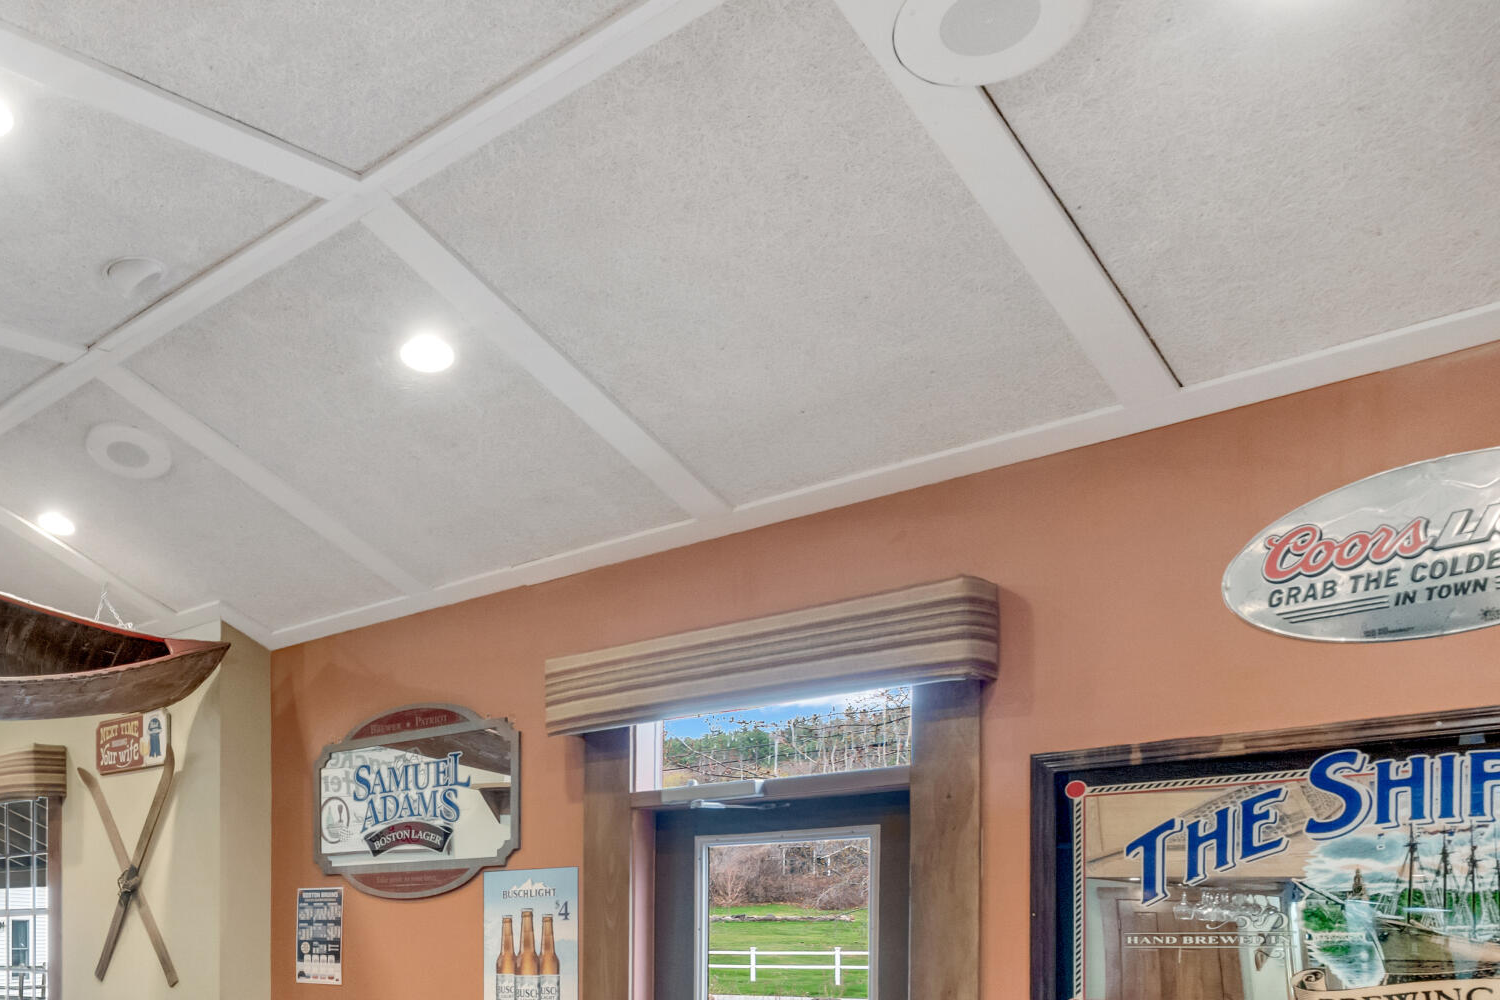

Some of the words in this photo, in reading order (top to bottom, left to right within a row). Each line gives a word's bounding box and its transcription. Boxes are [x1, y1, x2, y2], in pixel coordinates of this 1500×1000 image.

[1261, 517, 1431, 584] Coors
[1433, 503, 1500, 552] LI
[1268, 579, 1338, 608] GRAB
[1350, 567, 1400, 594] THE
[1394, 589, 1418, 607] IN
[1425, 577, 1489, 601] TOWN
[100, 724, 119, 744] NEXT
[120, 719, 139, 738] TIME
[117, 738, 139, 768] wife
[352, 750, 471, 802] SAMUEL
[360, 788, 461, 834] ADAMS
[373, 830, 410, 850] BOSTON
[411, 829, 444, 846] LAGER
[1125, 785, 1290, 907] THE
[502, 888, 529, 900] BUSCH
[529, 887, 557, 898] LIGHT
[1126, 934, 1178, 945] HAND
[1182, 934, 1266, 946] BREWED
[515, 988, 540, 998] BUSCH
